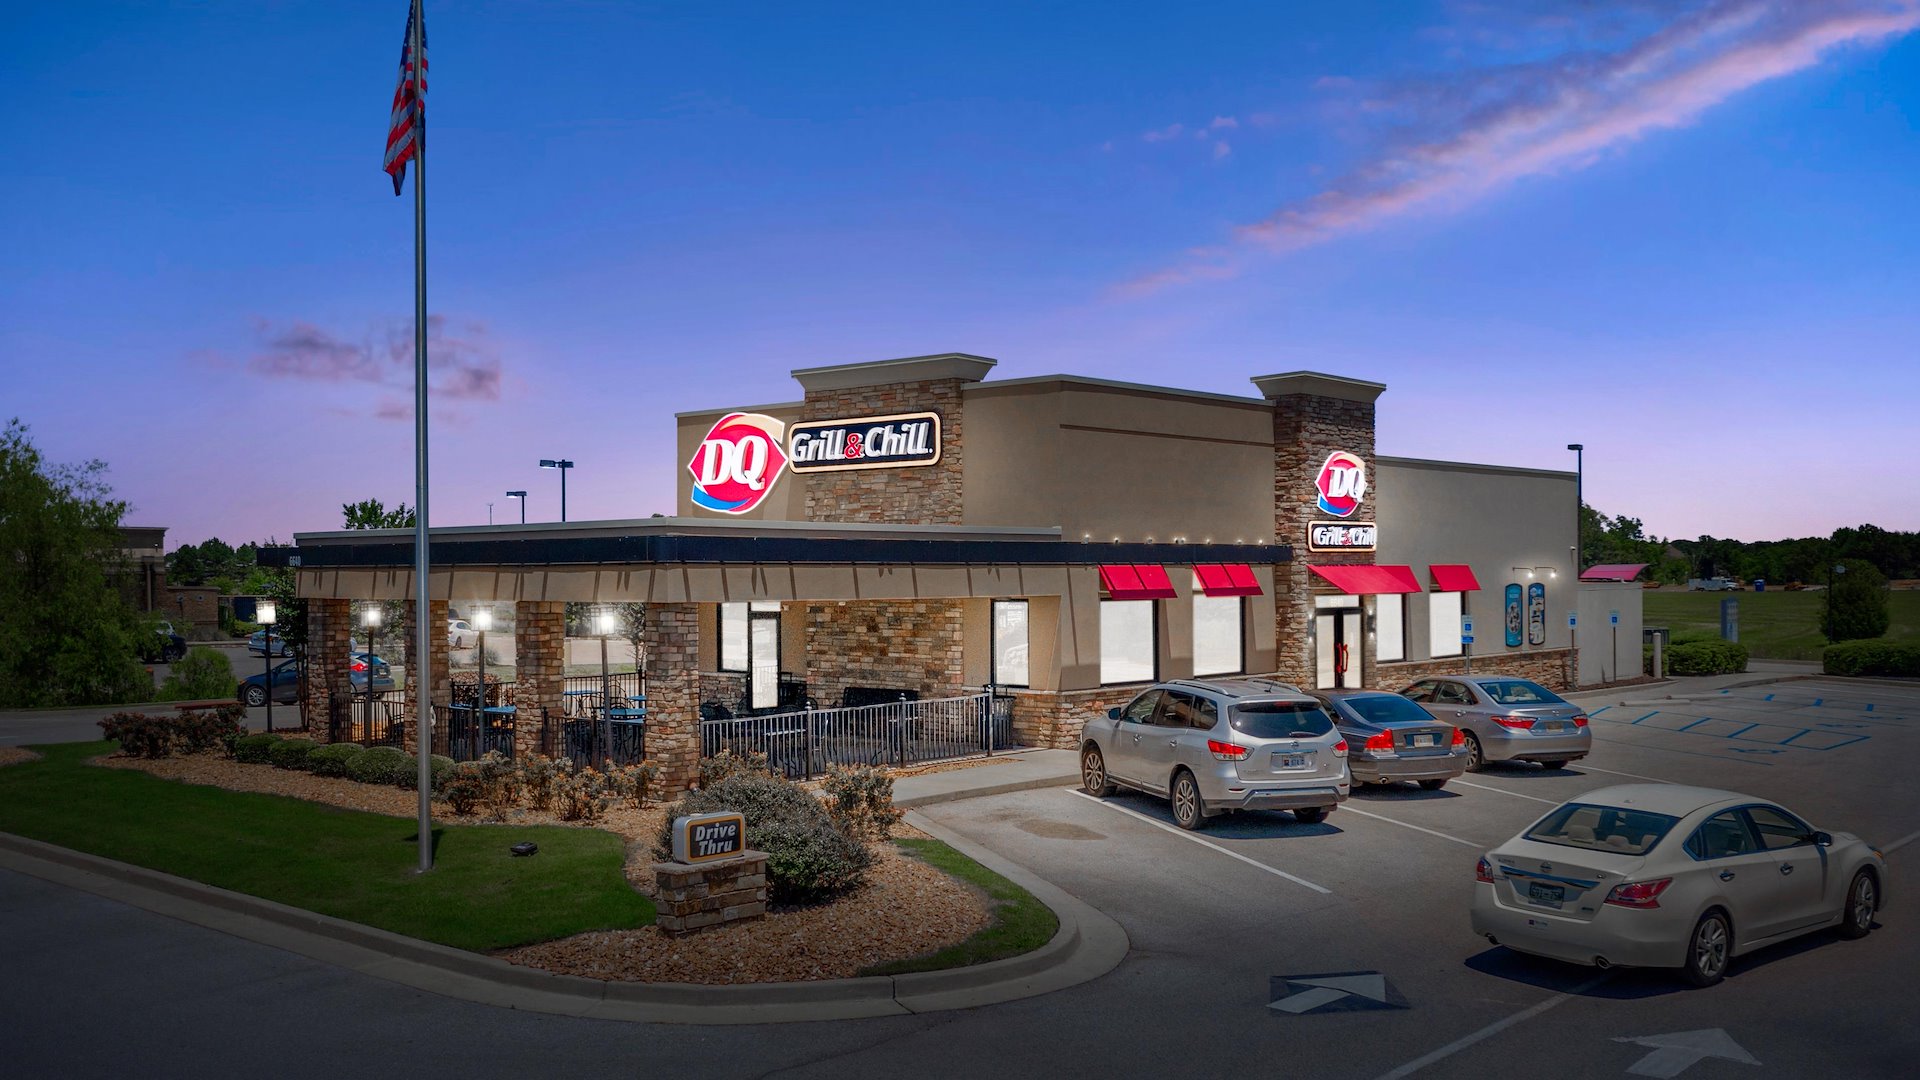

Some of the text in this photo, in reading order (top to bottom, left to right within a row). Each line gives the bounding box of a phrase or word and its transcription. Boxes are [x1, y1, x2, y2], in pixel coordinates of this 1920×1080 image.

[699, 435, 769, 490] DQ
[1327, 466, 1366, 503] DQ
[695, 822, 736, 841] Drive
[699, 840, 733, 856] Thru
